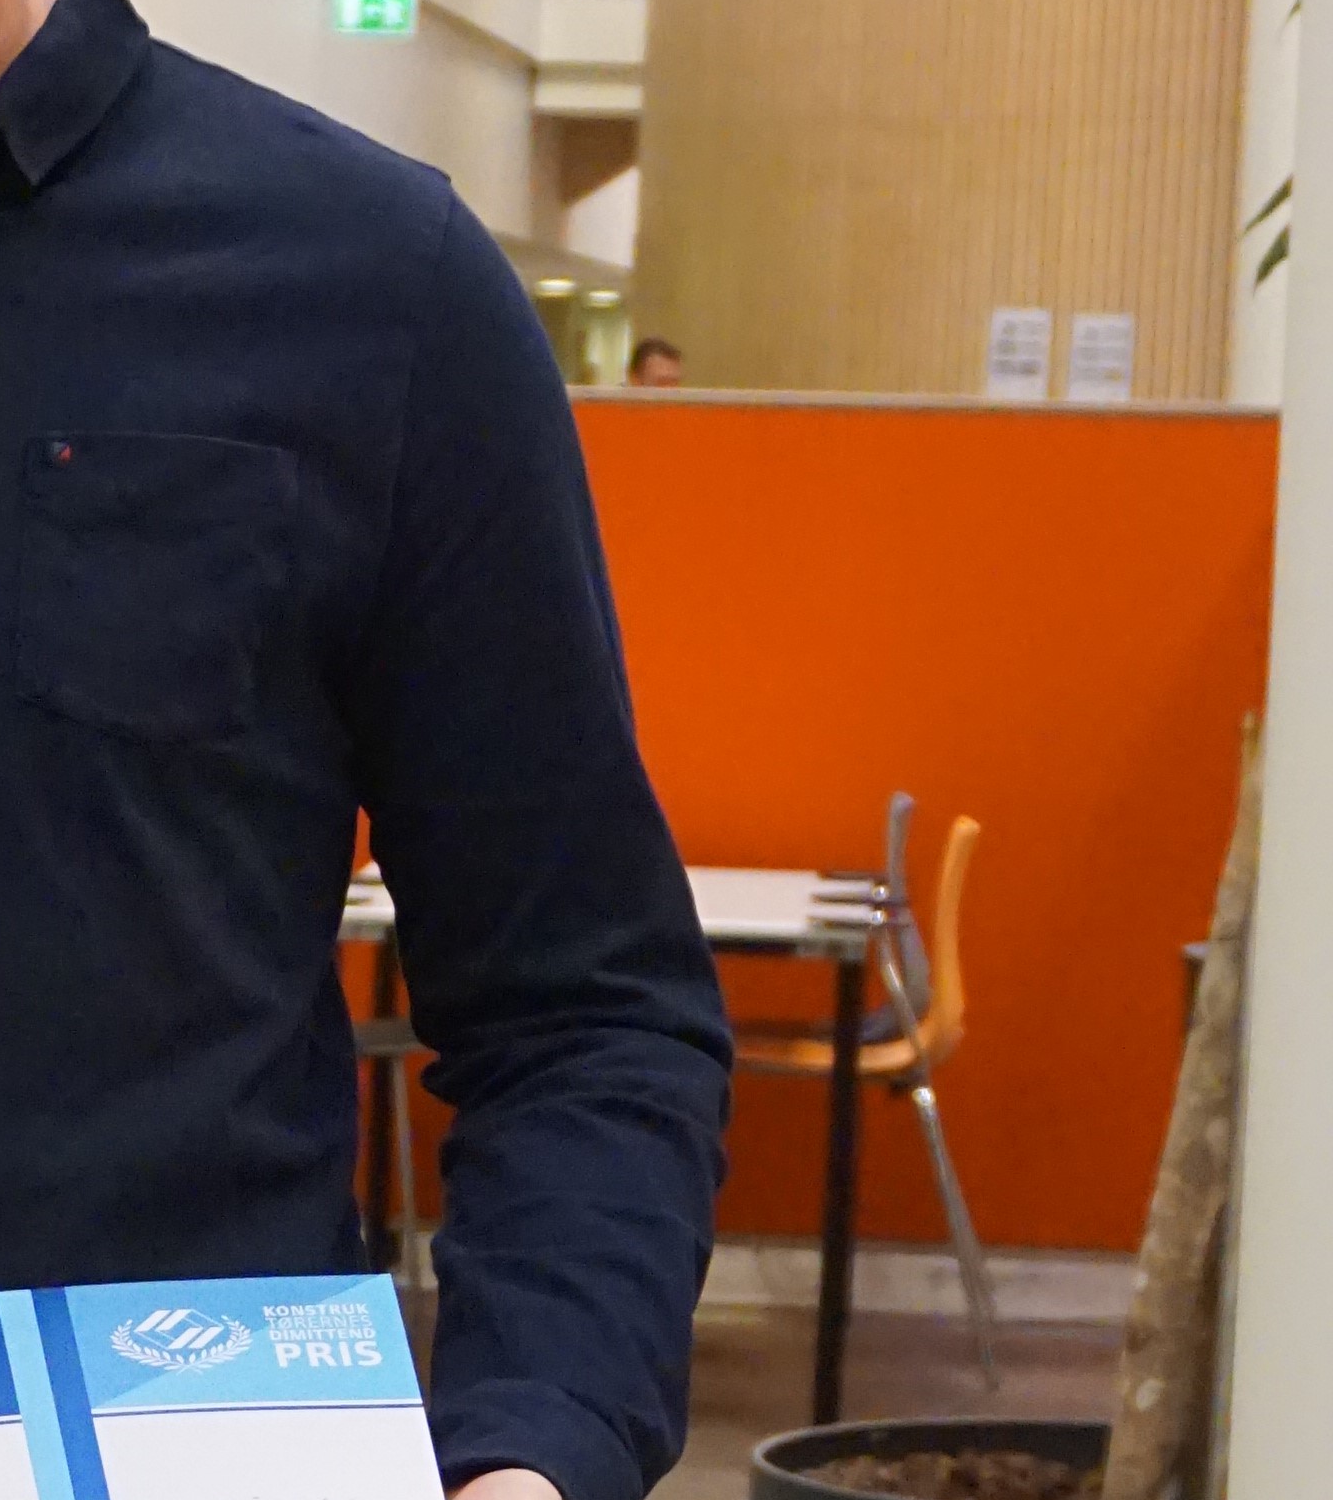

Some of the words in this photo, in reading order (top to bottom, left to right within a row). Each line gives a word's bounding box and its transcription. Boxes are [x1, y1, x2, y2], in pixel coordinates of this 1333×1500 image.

[263, 1303, 369, 1318] KONSTRUK
[265, 1314, 373, 1329] TØRERNES
[269, 1327, 376, 1341] DIMITTEND
[274, 1340, 383, 1369] PRIS
